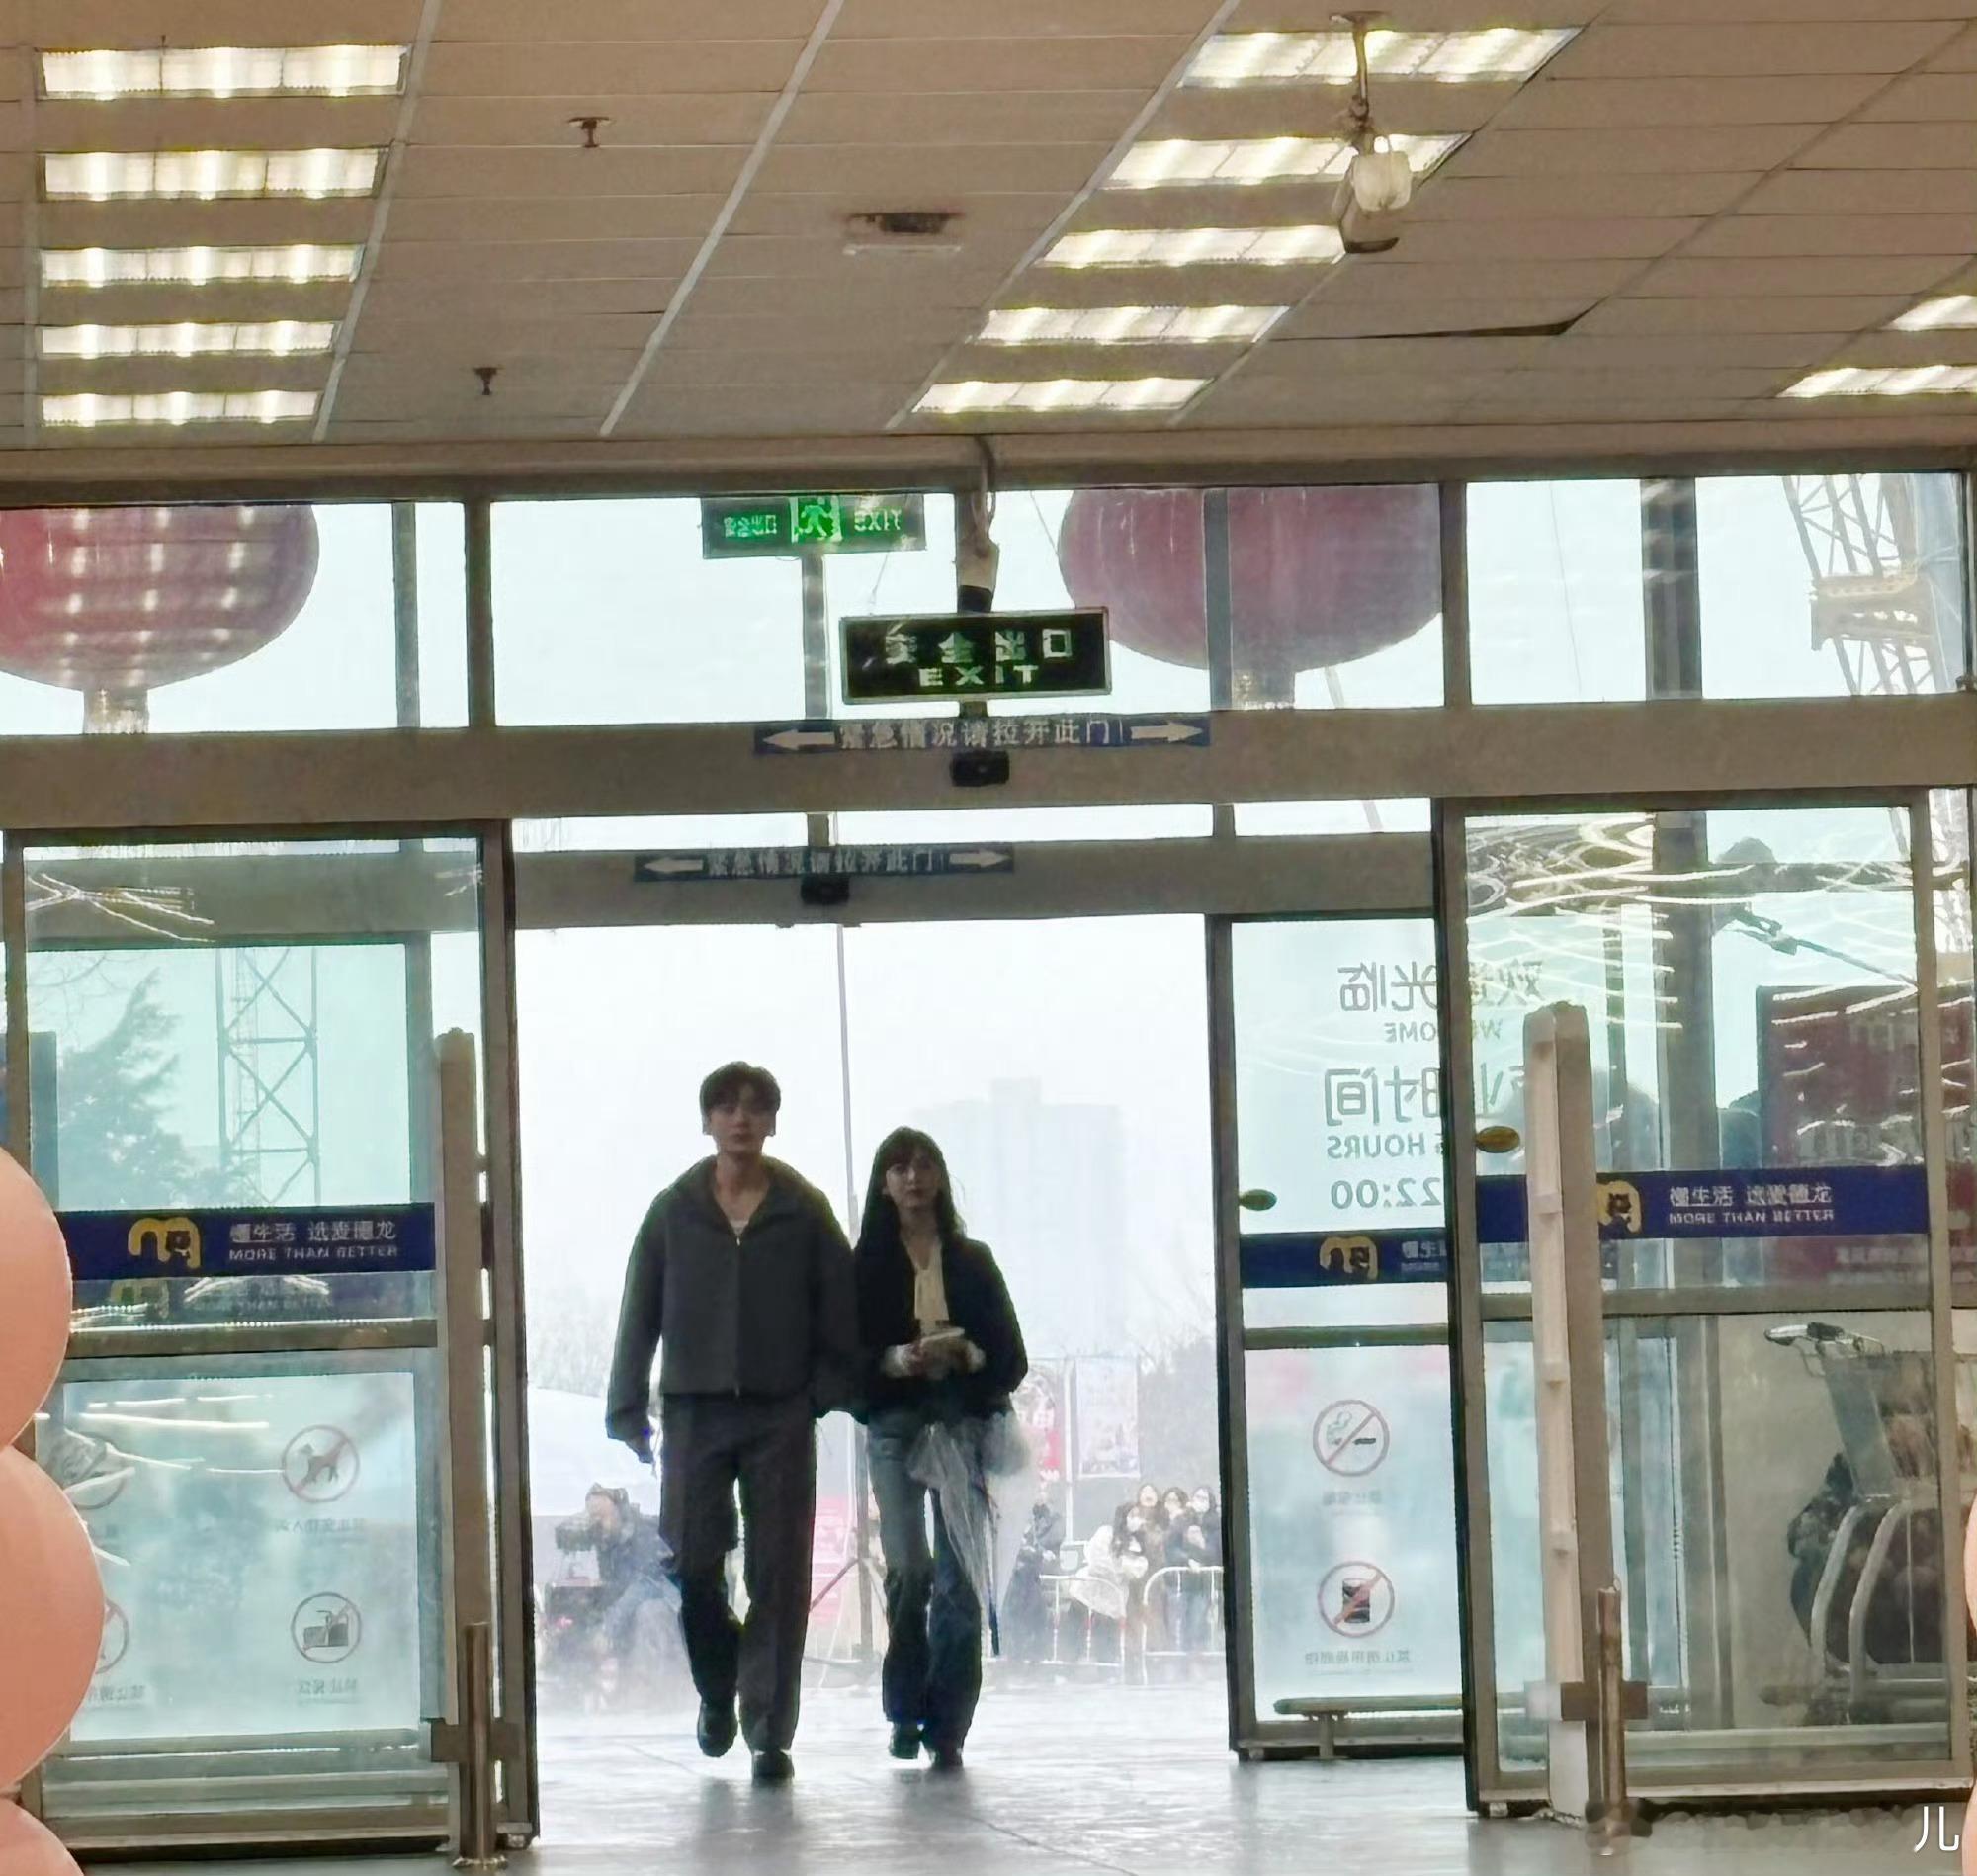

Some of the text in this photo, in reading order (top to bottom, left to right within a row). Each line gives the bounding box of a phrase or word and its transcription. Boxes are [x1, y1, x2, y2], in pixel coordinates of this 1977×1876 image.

[854, 508, 902, 532] EXIT
[917, 664, 1040, 687] EXIT
[1668, 1208, 1835, 1224] MORE THAN BETTER
[228, 1244, 398, 1261] MORE THAN BETTER
